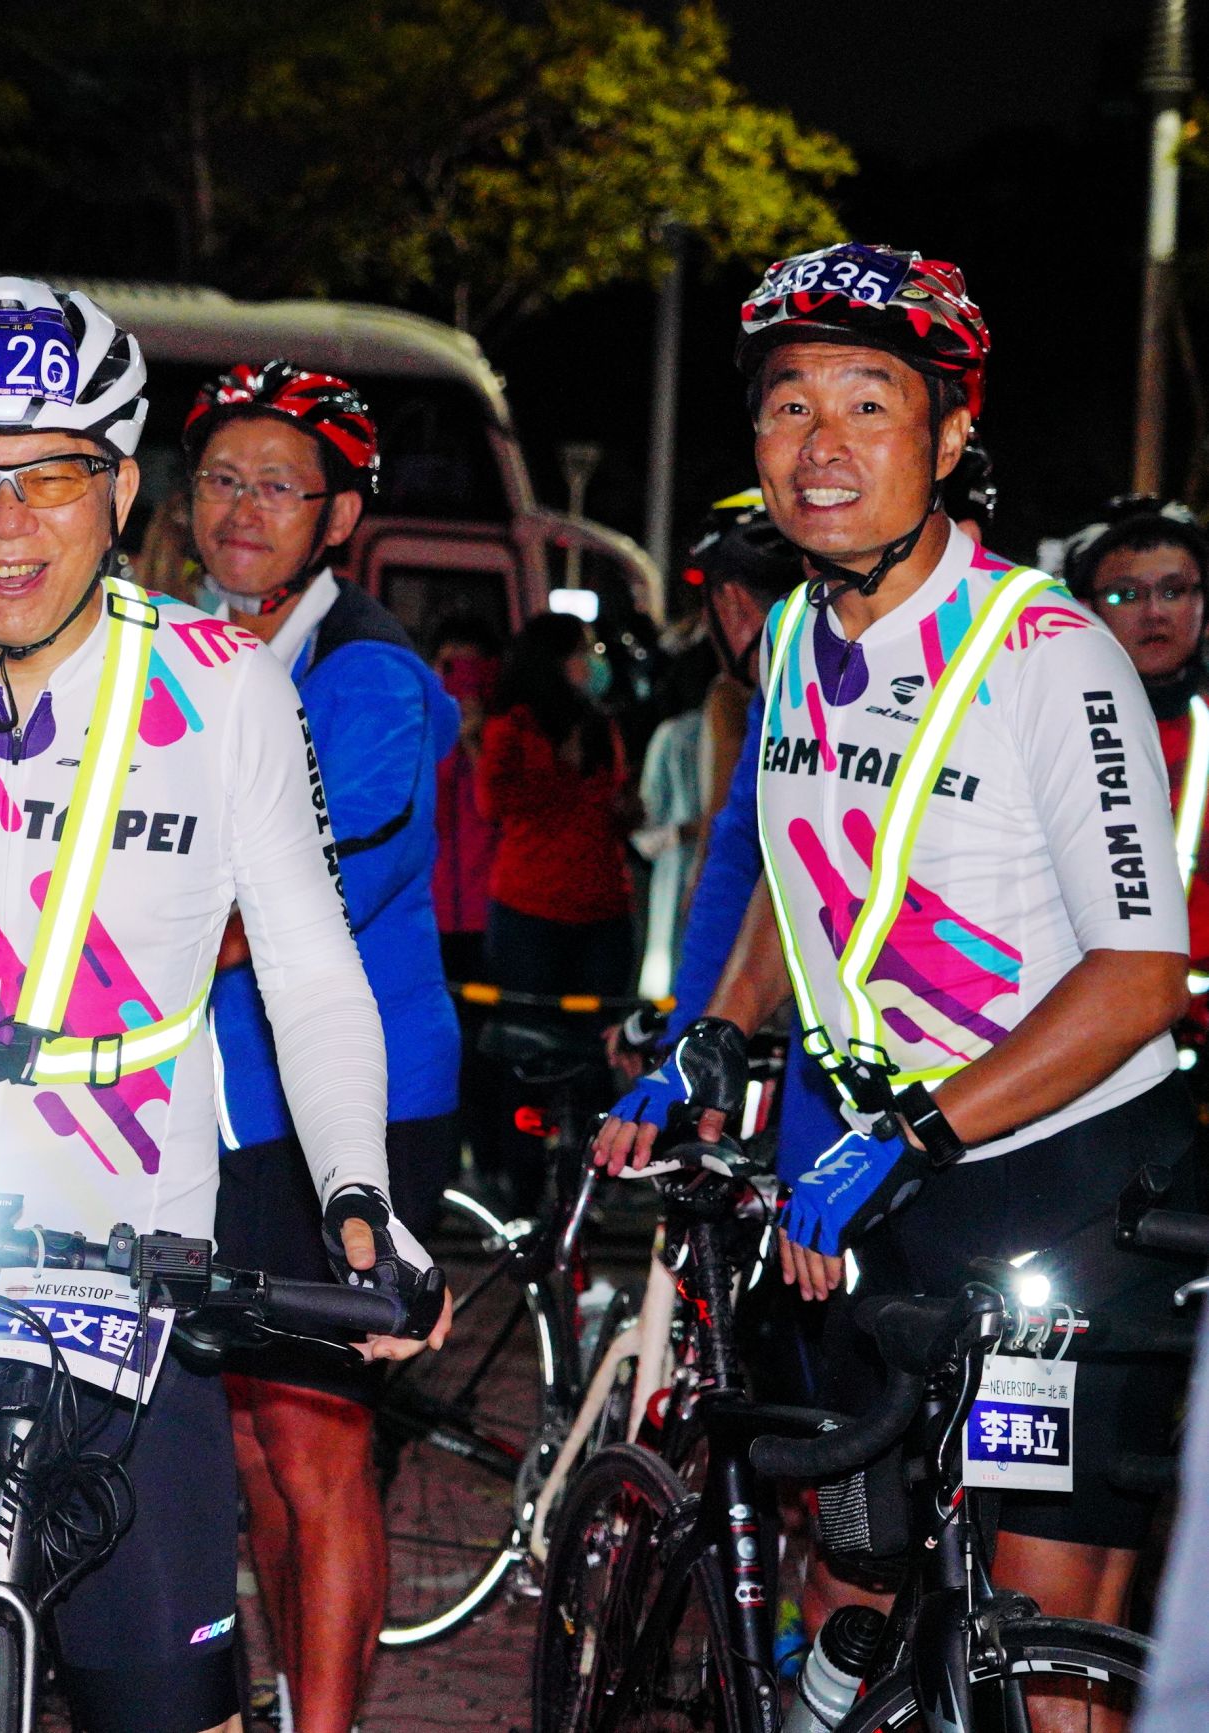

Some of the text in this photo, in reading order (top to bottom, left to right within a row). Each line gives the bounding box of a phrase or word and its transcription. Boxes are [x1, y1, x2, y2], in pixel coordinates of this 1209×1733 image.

[763, 736, 981, 802] EAM TAIEI
[24, 799, 198, 855] TPEI
[1083, 691, 1152, 920] TEAM TAIPEI
[35, 1283, 113, 1300] NEVERSTOP
[990, 1379, 1069, 1400] NEVERSTOP 北高
[979, 1409, 1060, 1457] 李再立
